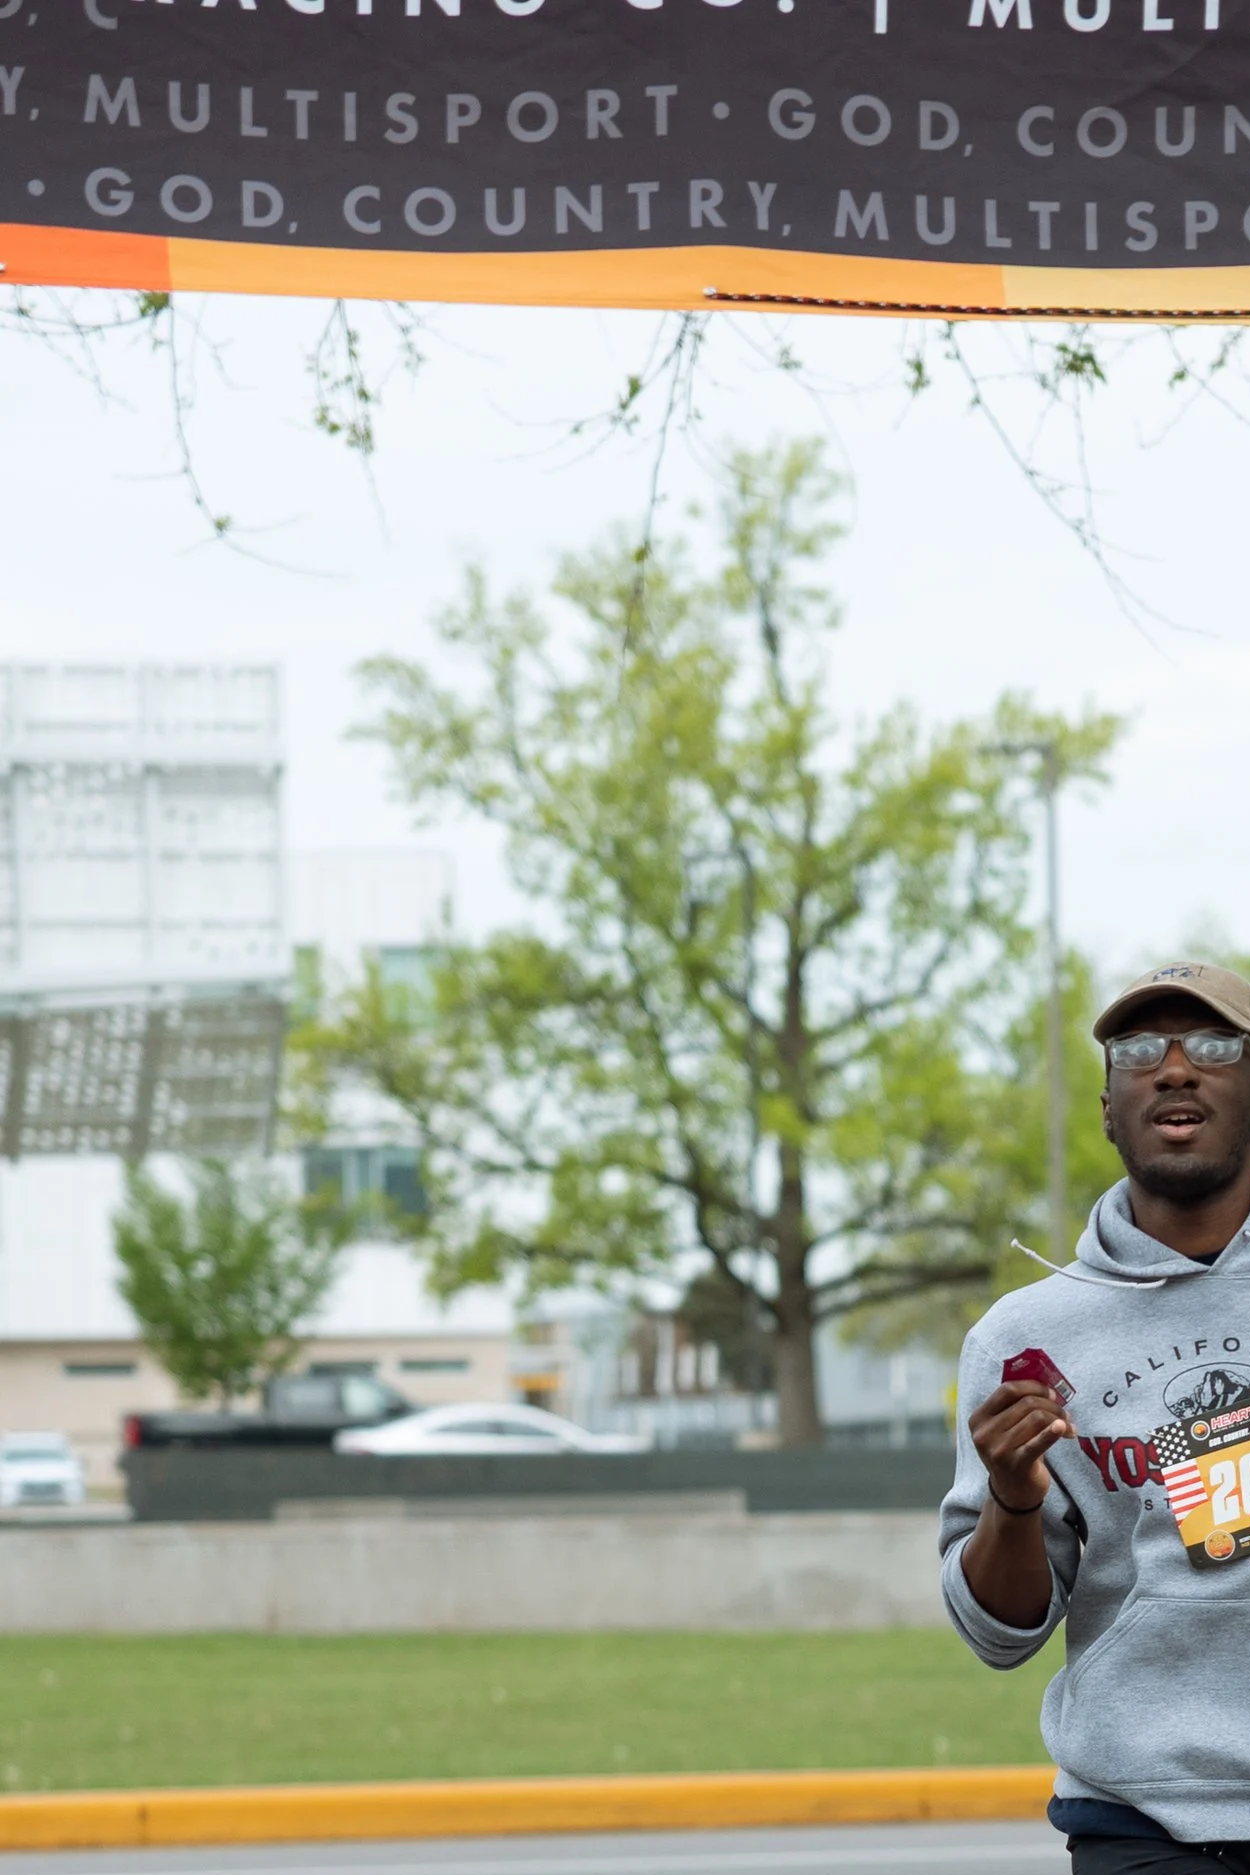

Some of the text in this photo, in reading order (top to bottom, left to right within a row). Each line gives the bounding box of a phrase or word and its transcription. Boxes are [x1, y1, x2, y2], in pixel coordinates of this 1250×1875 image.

[83, 74, 679, 144] MULTISPORT
[768, 88, 974, 157] GOD,
[84, 167, 300, 236] GOD,
[342, 179, 792, 237] COUNTRY,
